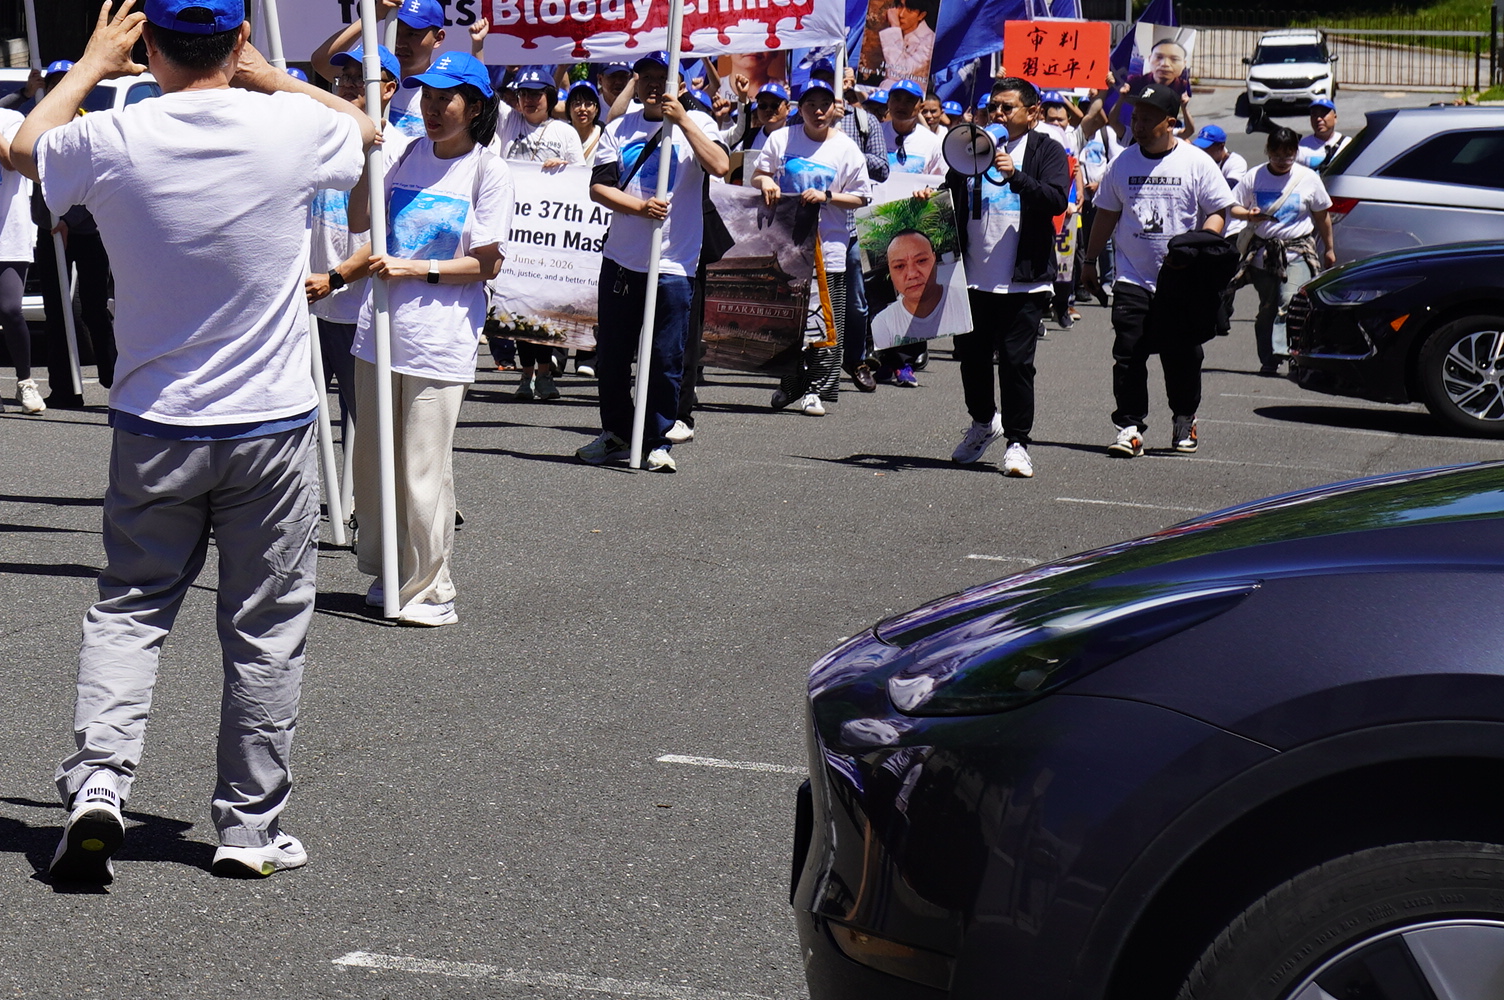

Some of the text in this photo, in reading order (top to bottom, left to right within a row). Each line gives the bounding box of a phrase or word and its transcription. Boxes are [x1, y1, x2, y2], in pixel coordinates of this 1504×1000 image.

[1027, 26, 1079, 52] 审判
[538, 200, 583, 223] 37th
[588, 206, 613, 226] An
[562, 230, 603, 253] Mas
[512, 254, 574, 270] June 4, 2026
[499, 268, 516, 277] ruth,
[517, 269, 543, 280] justice,
[544, 272, 558, 281] and
[565, 274, 586, 286] better
[587, 277, 598, 287] fut
[86, 787, 116, 801] PUMA
